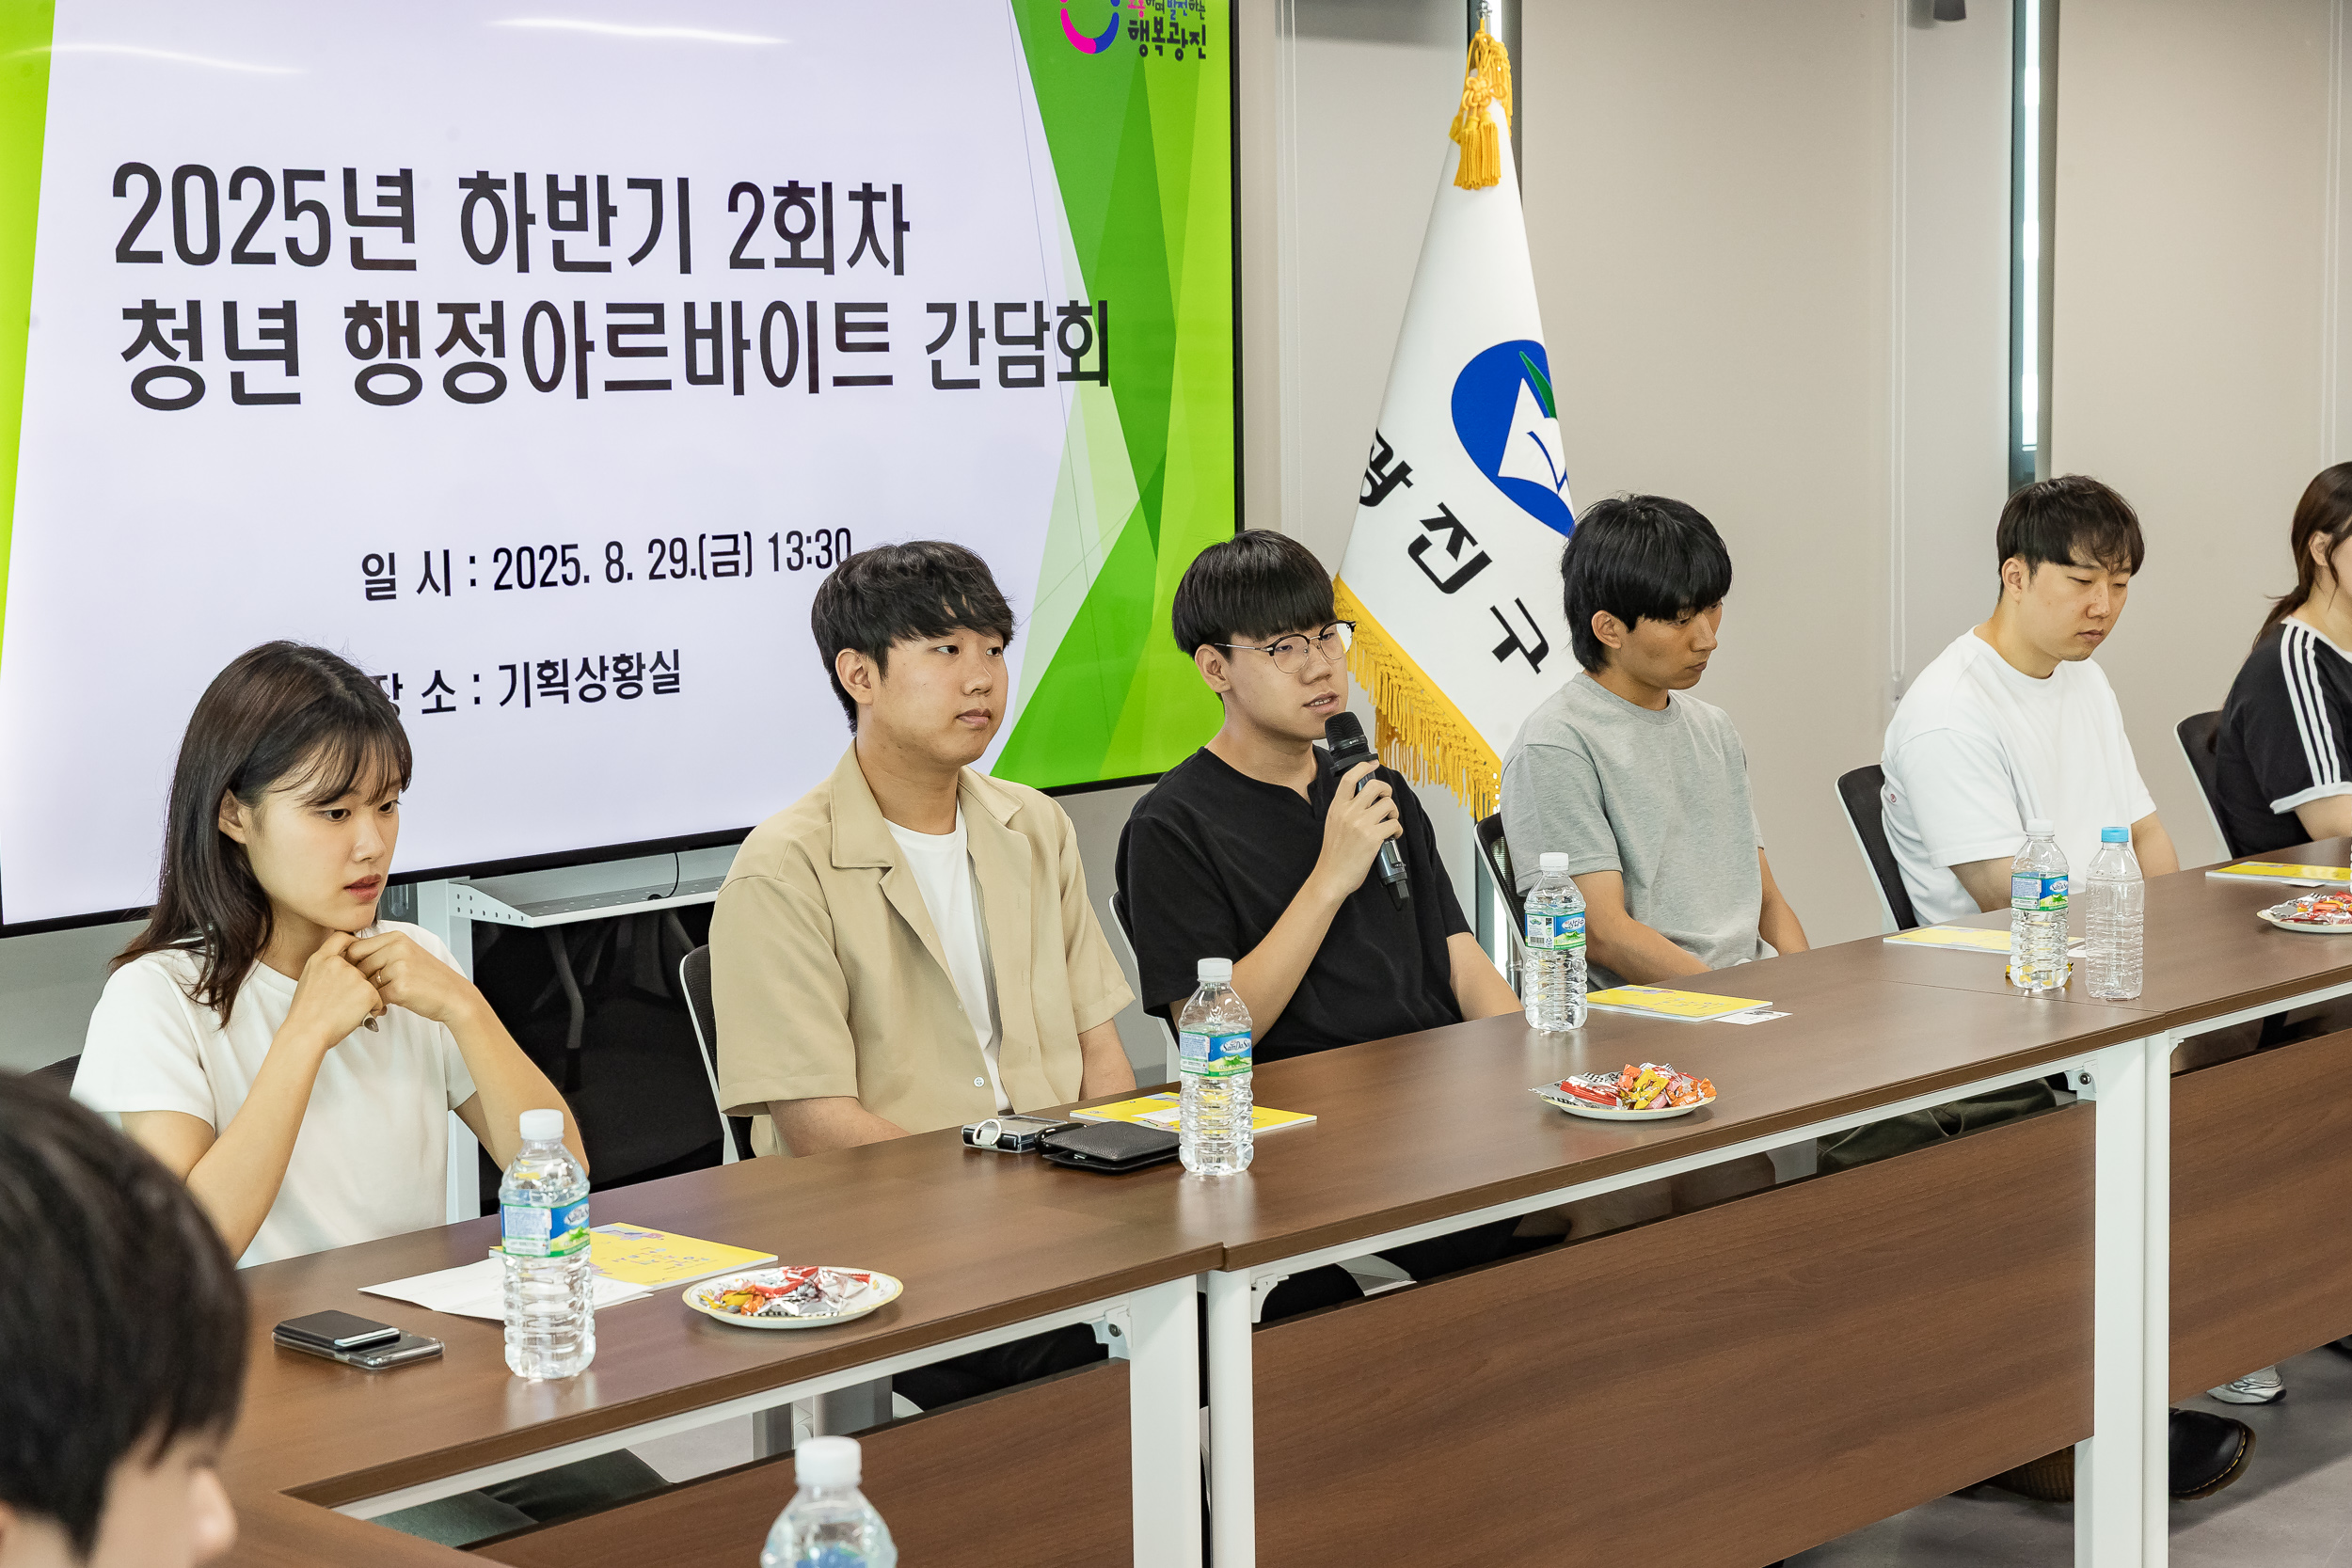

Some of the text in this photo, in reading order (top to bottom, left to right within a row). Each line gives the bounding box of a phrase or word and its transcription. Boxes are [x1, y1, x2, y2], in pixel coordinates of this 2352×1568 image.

[1127, 16, 1206, 61] 행복광진
[112, 162, 911, 276] 2025년 하반기 2회차
[120, 299, 1109, 411] 청년 행정아르바이트 간담회
[493, 544, 590, 591] 2025.
[605, 541, 633, 584] 8.
[647, 531, 753, 580] 29.(금)
[768, 527, 852, 572] 13:30
[499, 648, 680, 708] 기획상황실
